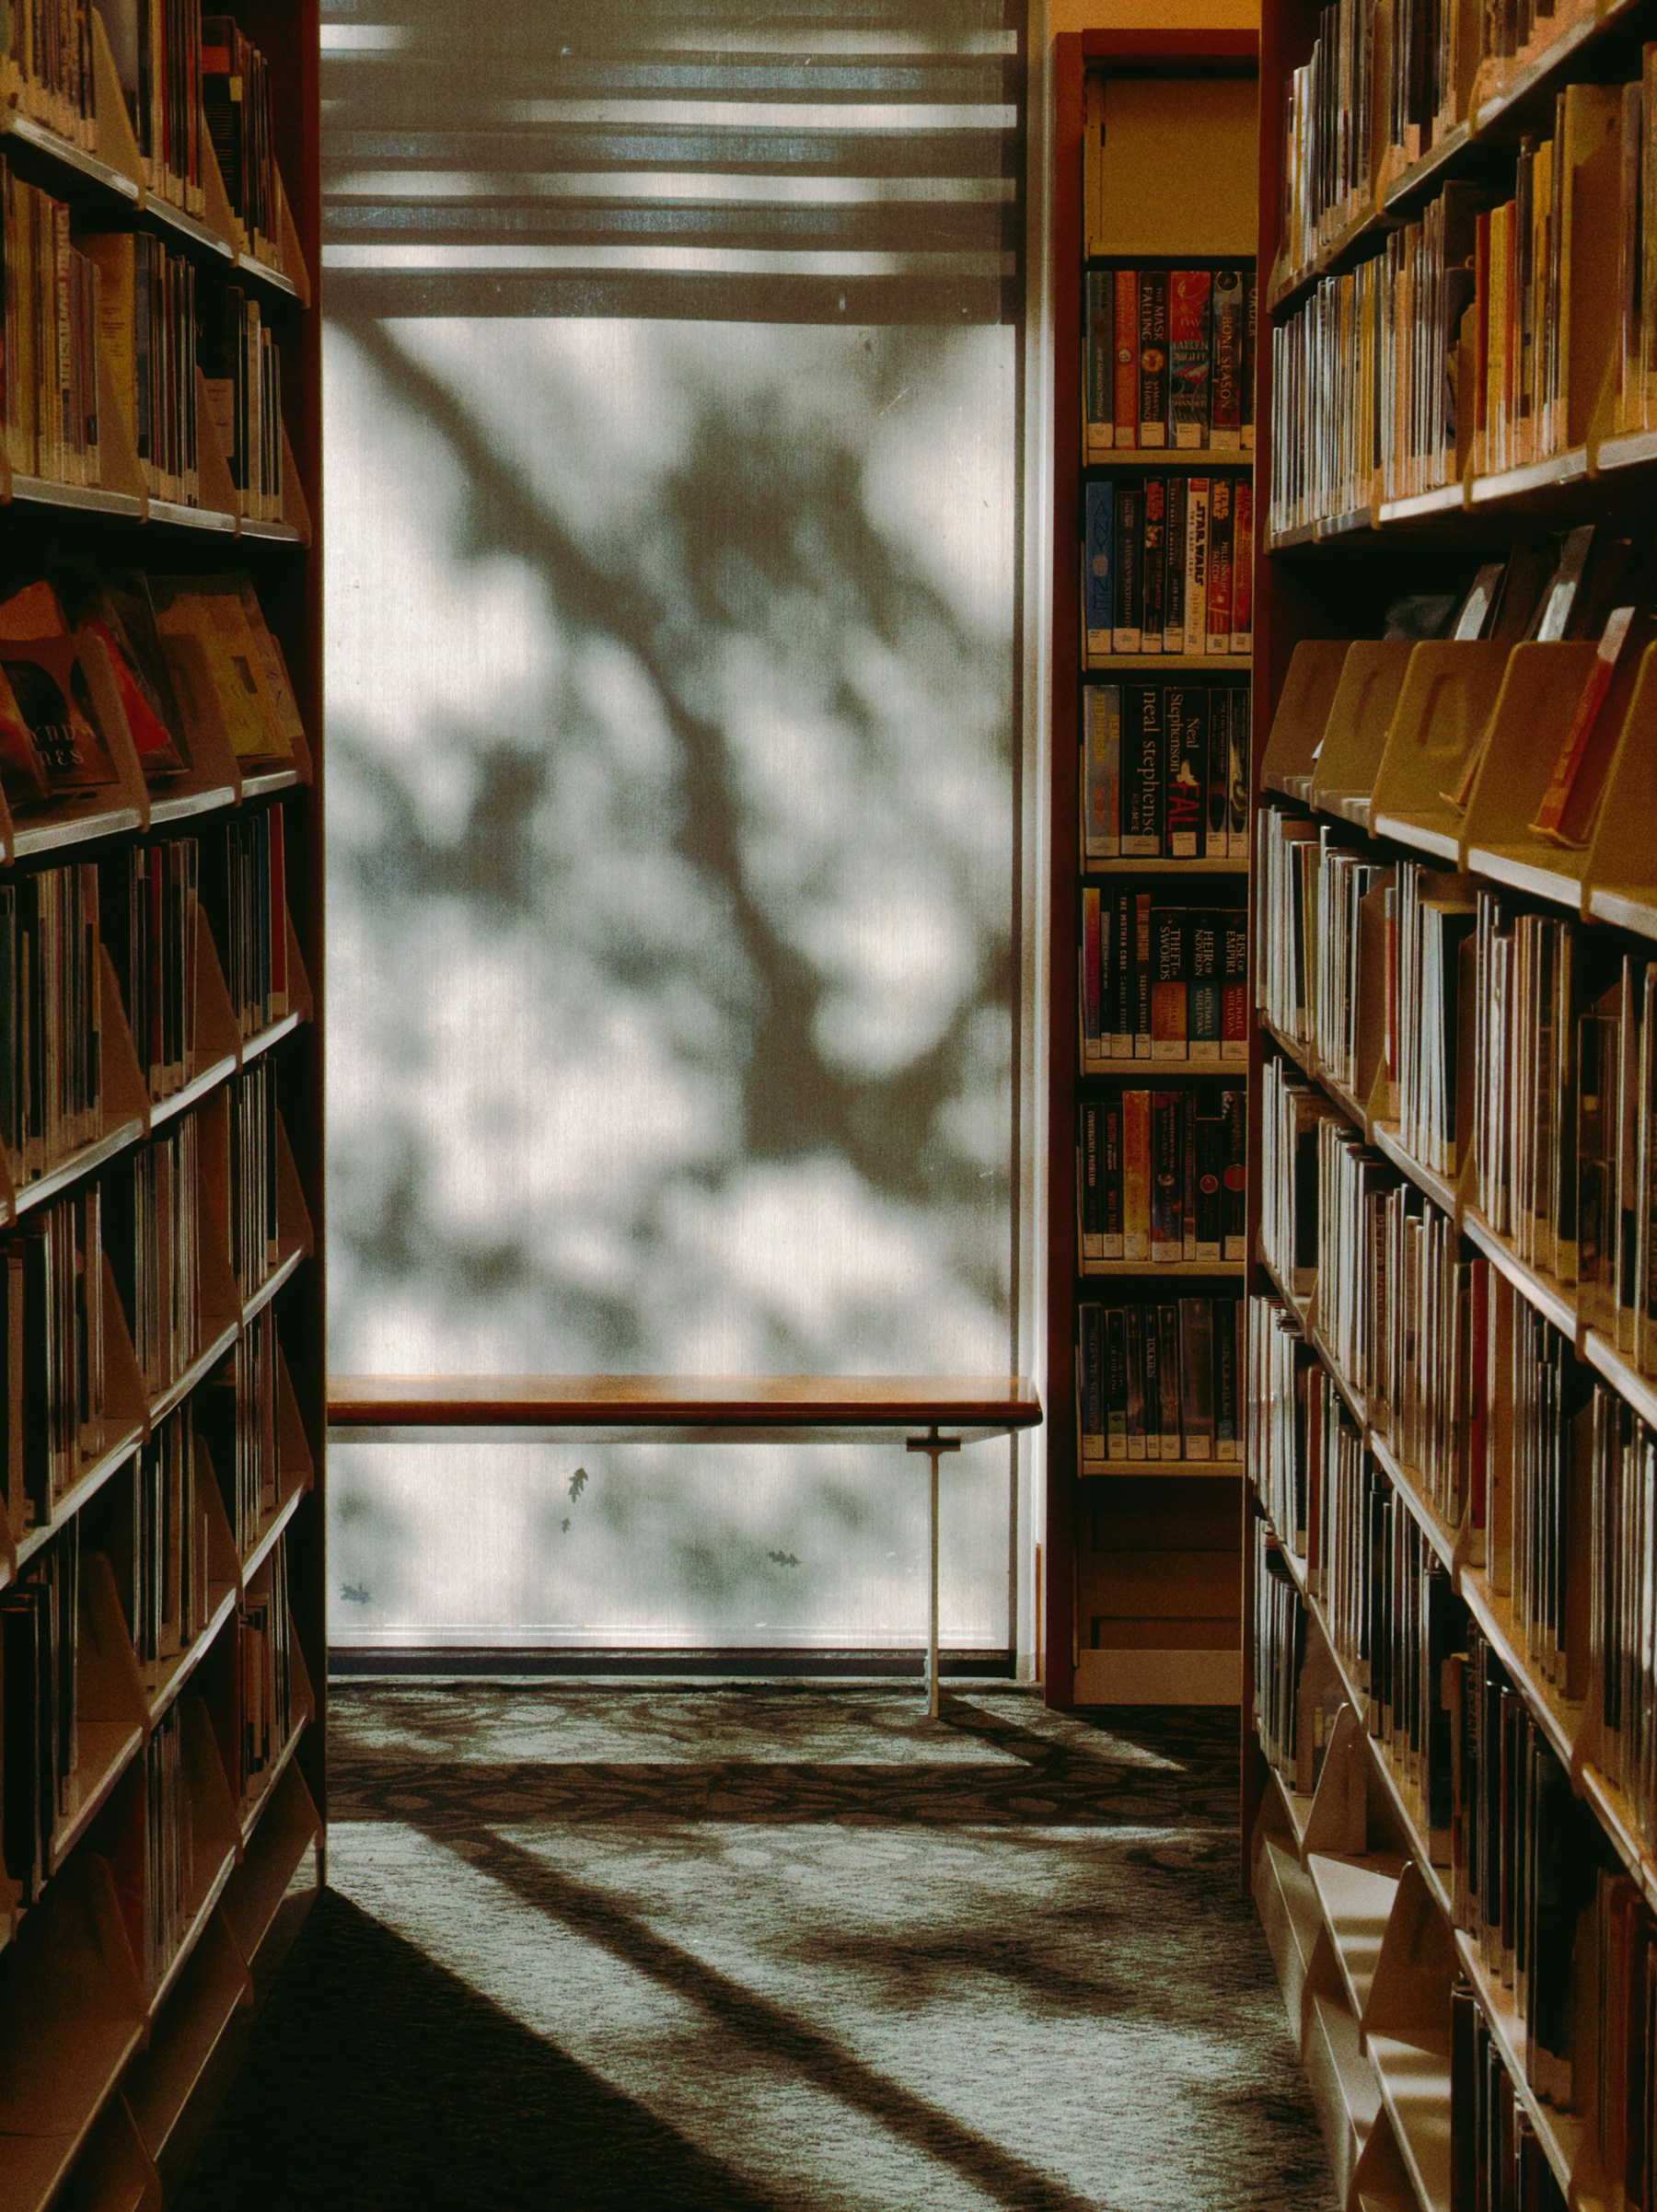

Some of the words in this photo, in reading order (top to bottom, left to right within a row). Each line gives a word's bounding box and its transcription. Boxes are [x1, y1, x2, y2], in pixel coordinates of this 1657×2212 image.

[1141, 286, 1153, 341] FALLING
[1153, 306, 1164, 341] MASK
[1222, 317, 1233, 352] BONE
[1144, 380, 1153, 423] SHANNO
[1220, 355, 1232, 409] SEASON
[1197, 501, 1205, 542] STAR
[1195, 544, 1204, 585] WARS
[1143, 691, 1161, 732] neal
[1167, 693, 1184, 772] Stephenson
[1187, 718, 1200, 748] Neal
[1137, 740, 1161, 836] stephenso
[1160, 927, 1170, 979] SWORDS
[1170, 928, 1180, 968] THEFT
[1195, 930, 1203, 976] NOVRON
[1204, 932, 1213, 961] HEIR
[1226, 931, 1235, 975] EMPIRE
[1236, 934, 1246, 960] RISE
[1196, 990, 1204, 1035] SULLIVAN
[1147, 1337, 1155, 1378] TOLKIEN
